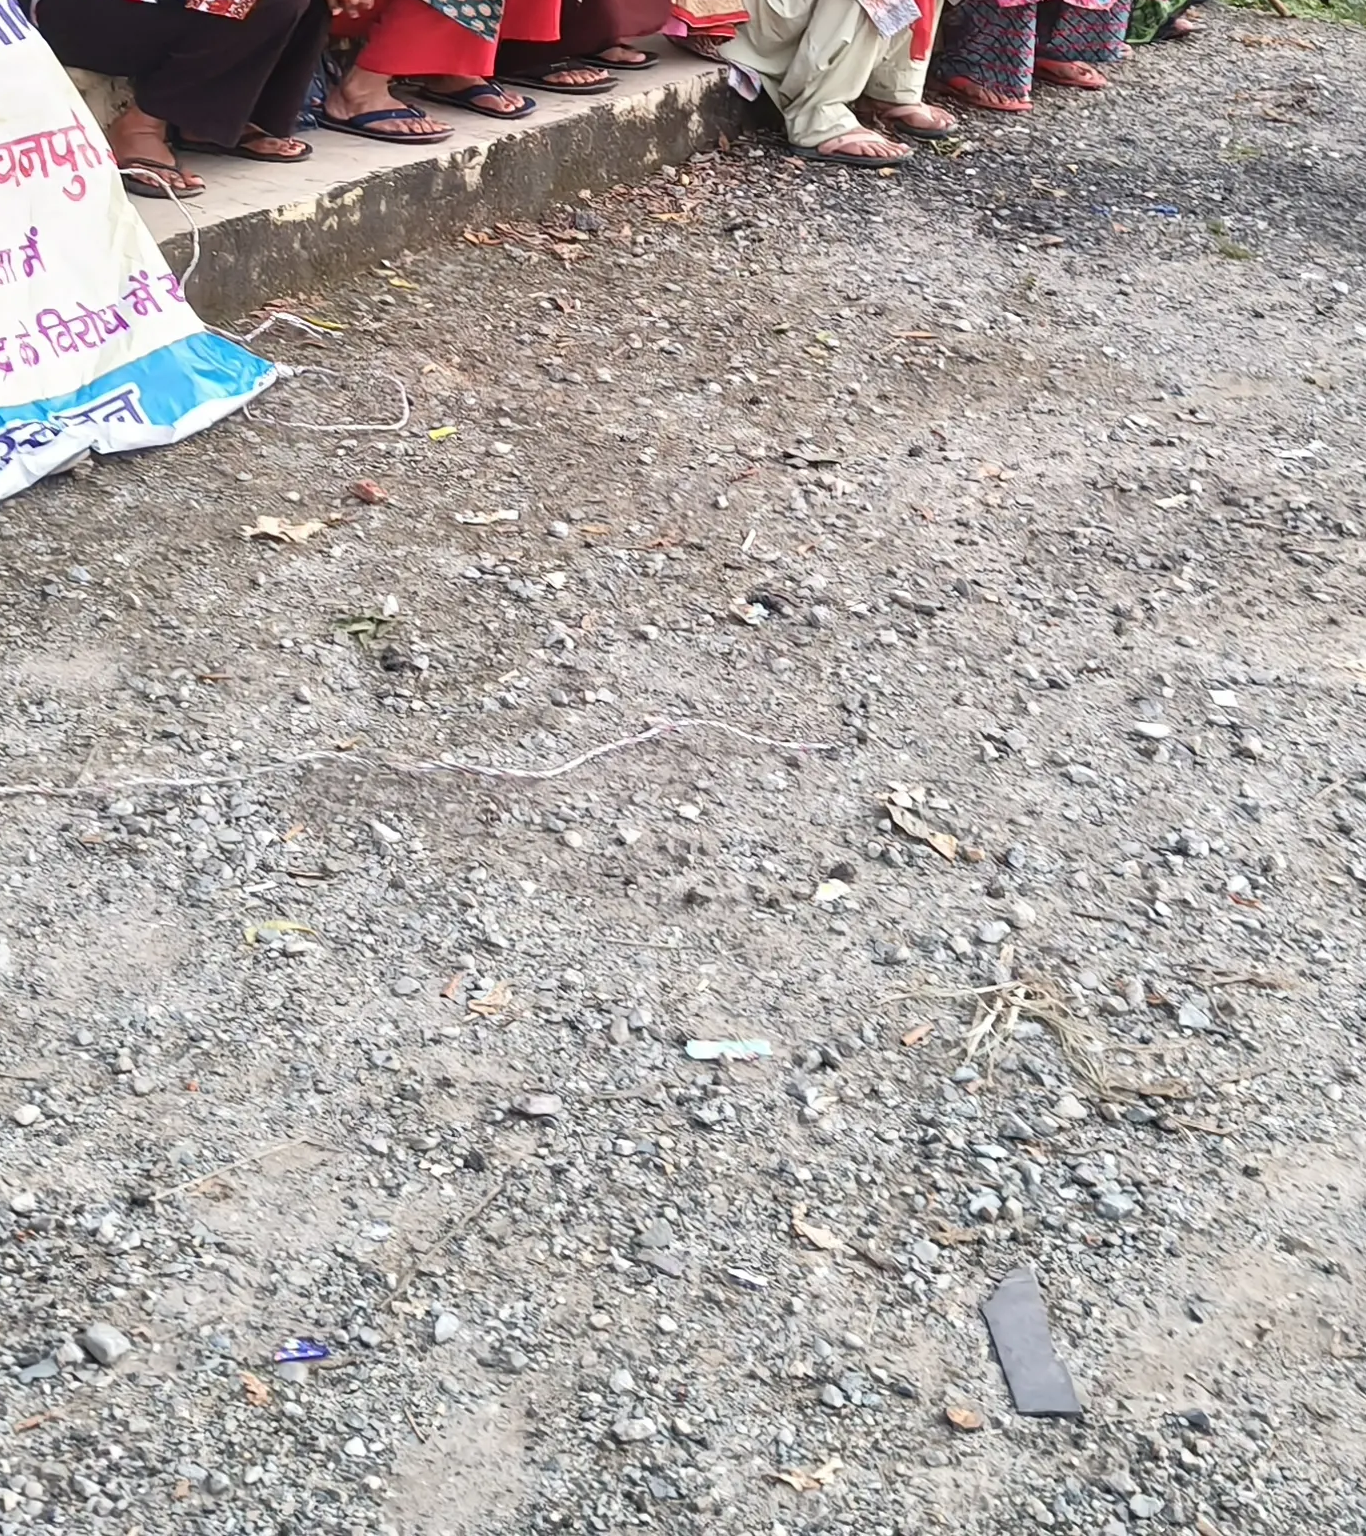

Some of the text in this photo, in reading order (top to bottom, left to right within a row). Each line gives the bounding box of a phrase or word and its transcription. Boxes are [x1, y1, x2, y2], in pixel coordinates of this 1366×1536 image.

[19, 226, 47, 277] में
[36, 301, 131, 358] विरोध
[122, 269, 164, 316] में
